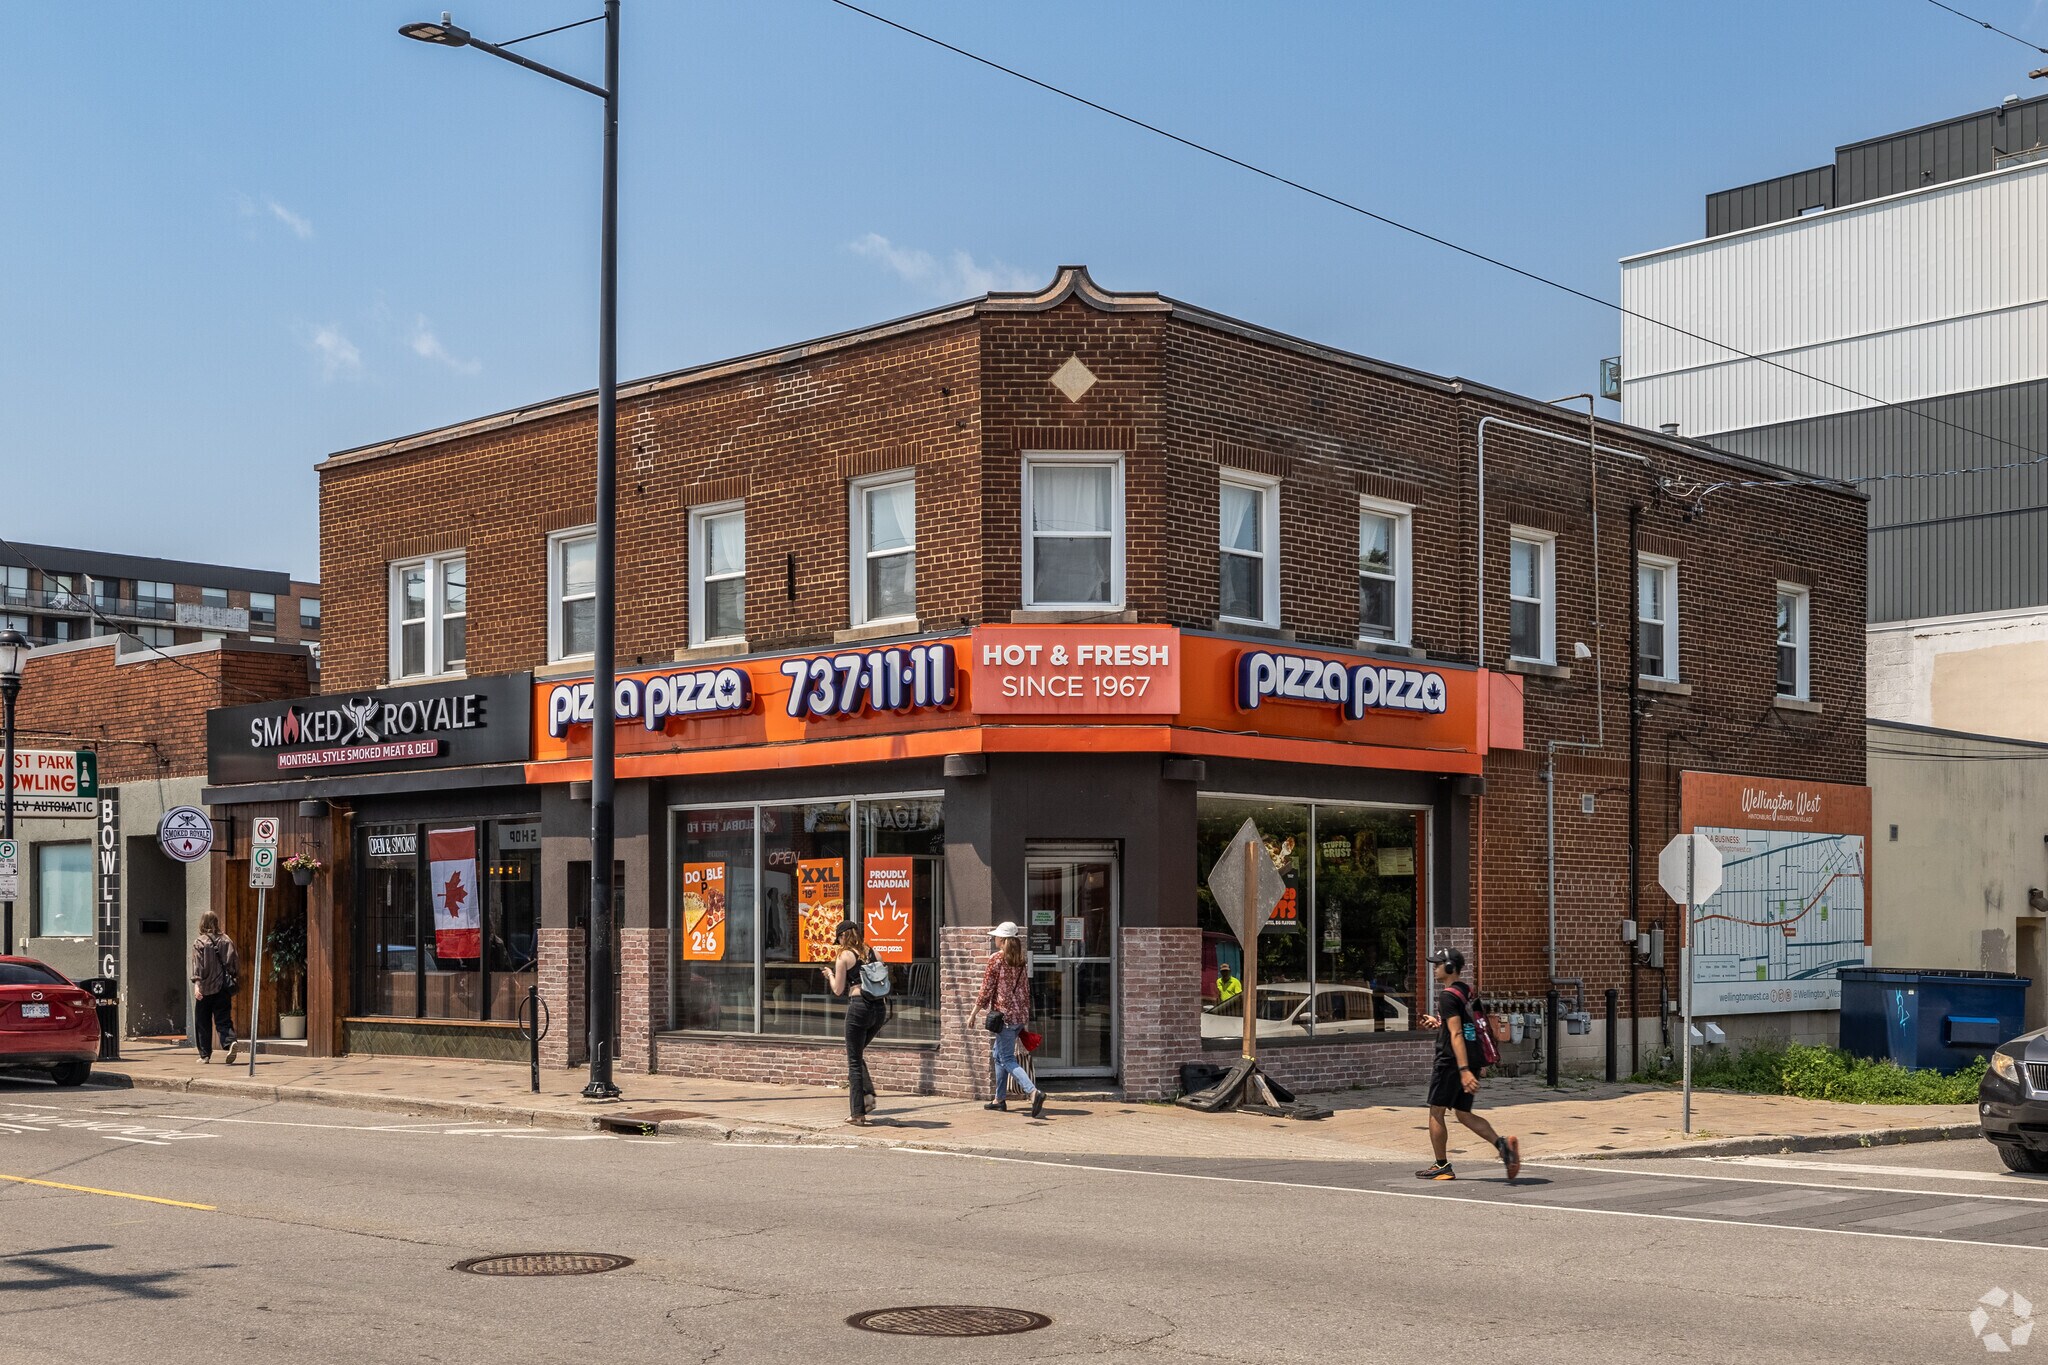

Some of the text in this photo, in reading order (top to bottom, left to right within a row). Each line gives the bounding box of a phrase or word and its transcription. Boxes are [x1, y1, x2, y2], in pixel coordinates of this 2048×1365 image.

[983, 645, 1169, 666] HOT & FRESH
[1002, 675, 1151, 697] SINCE 1967
[1249, 652, 1447, 720] pizza pizza
[549, 667, 742, 738] piza pizza
[384, 694, 477, 736] ROYALE
[279, 741, 434, 766] MONTREAL STYLE SMOKED MEAT & DELI
[0, 754, 74, 769] ST PARK
[0, 801, 93, 813] ULY AUTOMATIC
[1742, 788, 1821, 822] Wellington West
[164, 829, 210, 840] SMOKED ROYALE
[4, 846, 11, 854] P
[370, 837, 385, 854] OPEN
[385, 837, 391, 853] &
[1323, 841, 1351, 849] STUFFED
[261, 853, 269, 862] P
[769, 851, 800, 865] OPEN
[1324, 848, 1351, 858] CRUST
[685, 867, 723, 884] DOUBLE
[801, 867, 840, 883] XXL
[870, 870, 907, 879] PROUDLY
[867, 879, 910, 888] CANADIAN
[1719, 992, 1769, 1003] wellingtonwest.ca
